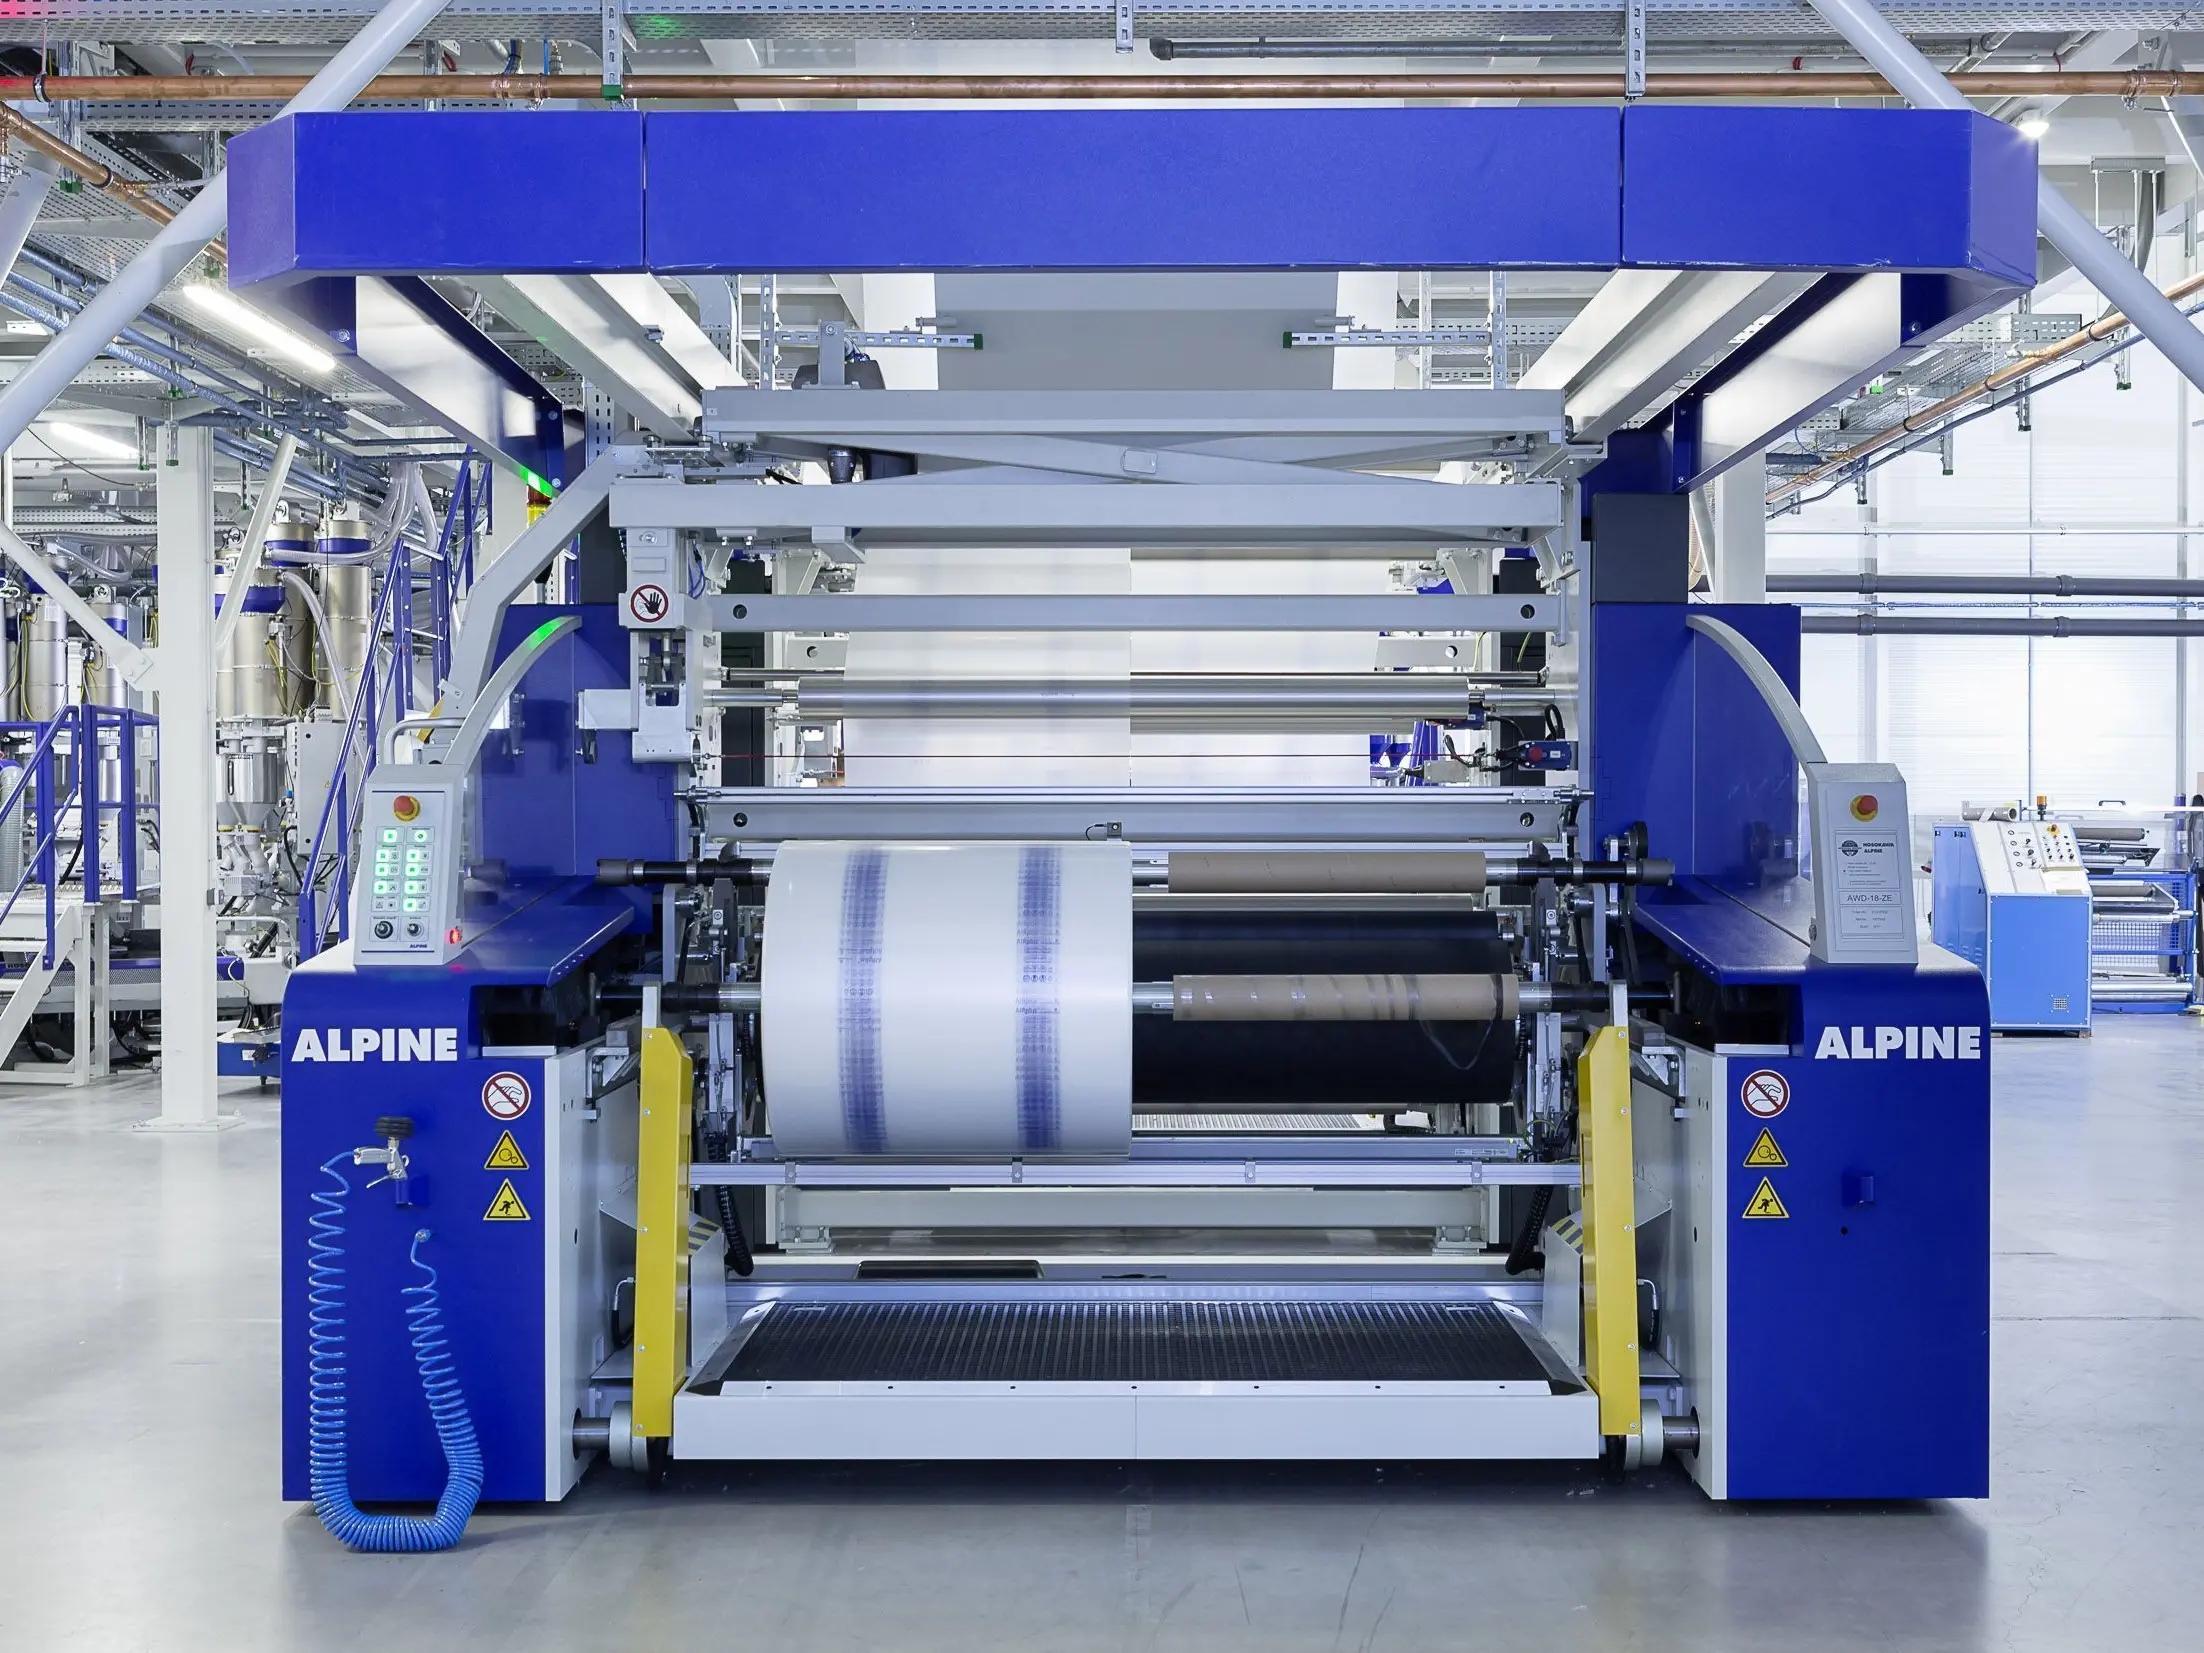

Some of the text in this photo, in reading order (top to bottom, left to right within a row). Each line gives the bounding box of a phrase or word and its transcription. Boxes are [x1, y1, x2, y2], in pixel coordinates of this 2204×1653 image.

[1846, 894, 1893, 902] AWD-18-ZE
[291, 1028, 458, 1062] ALPINE
[1814, 1026, 1981, 1060] ALPINE
